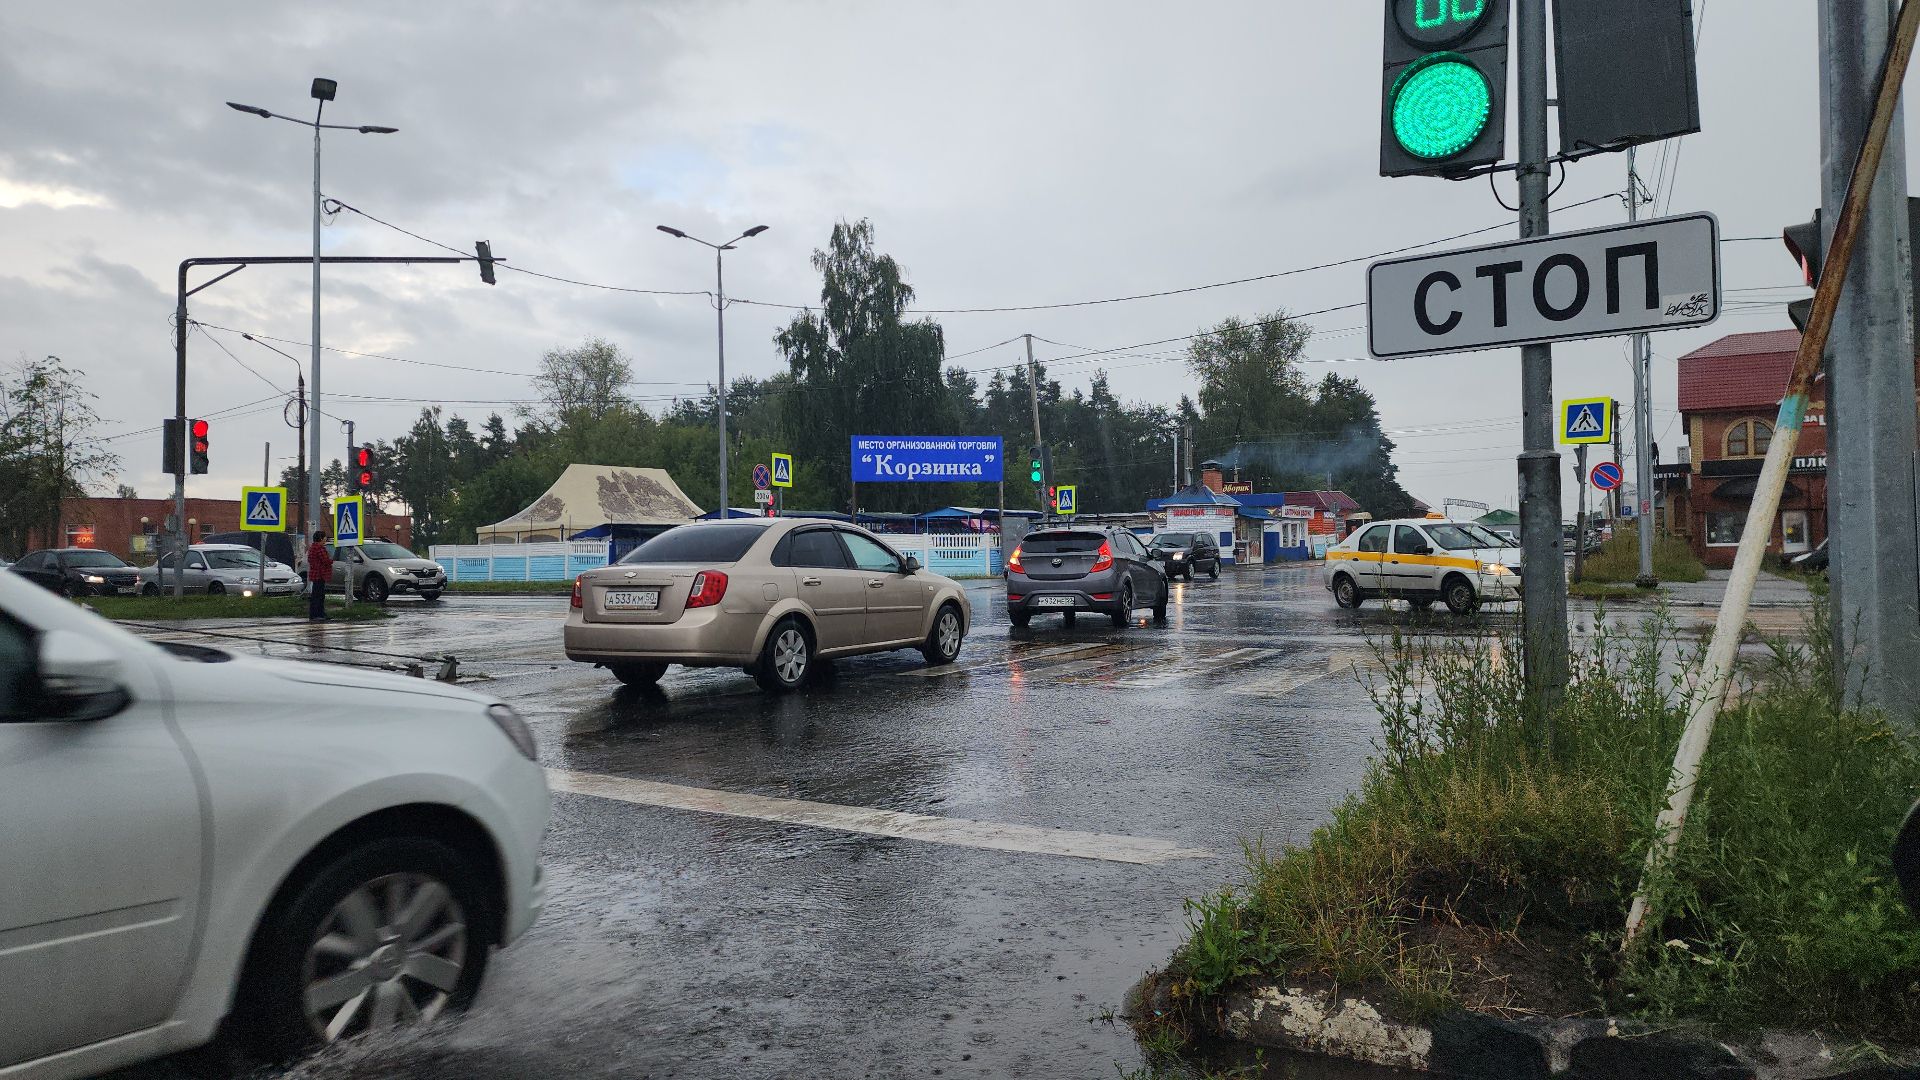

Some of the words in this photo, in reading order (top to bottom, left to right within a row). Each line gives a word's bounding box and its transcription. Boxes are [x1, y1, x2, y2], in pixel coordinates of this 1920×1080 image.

[1414, 241, 1660, 336] СТОП
[858, 440, 885, 450] МЕСТО
[886, 439, 956, 450] ОРГАНИЗОВАННОЙ
[958, 440, 997, 450] ТОРГОВЛИ
[1653, 472, 1680, 480] ЦВЕТЫ
